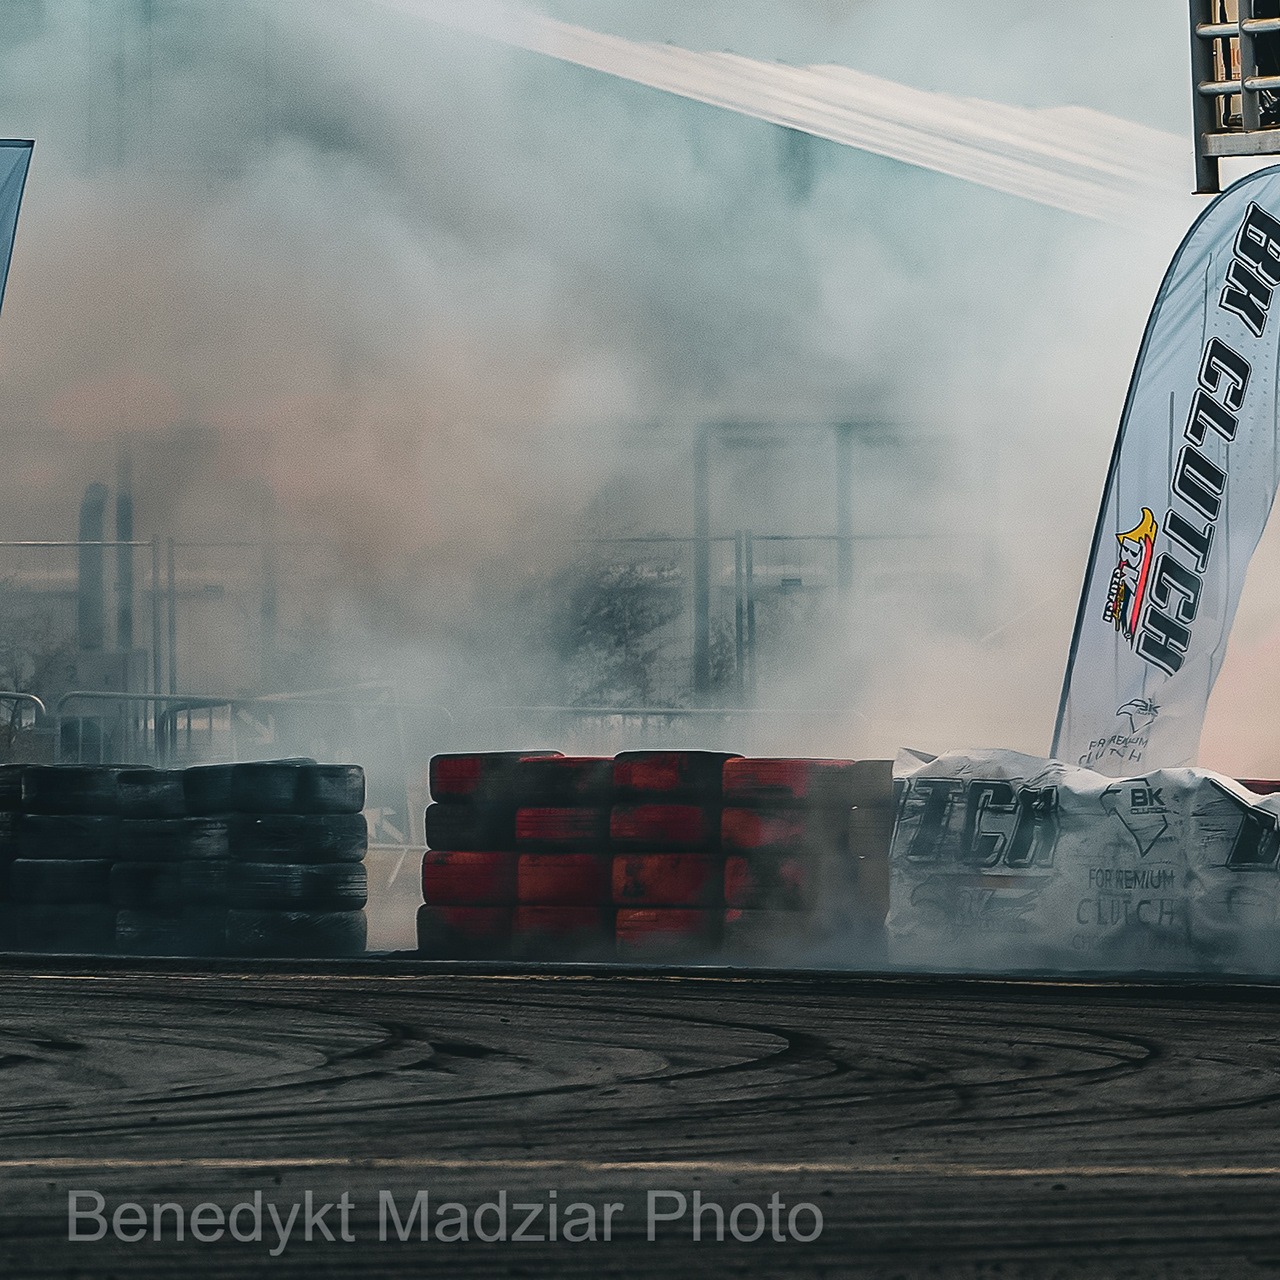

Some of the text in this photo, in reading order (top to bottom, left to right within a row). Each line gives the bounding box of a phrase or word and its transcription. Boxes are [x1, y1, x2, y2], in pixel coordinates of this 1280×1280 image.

[1135, 335, 1254, 677] CLUTCH
[1130, 787, 1166, 807] BK
[1088, 869, 1113, 890] FOR
[1076, 897, 1175, 926] CLUTCH
